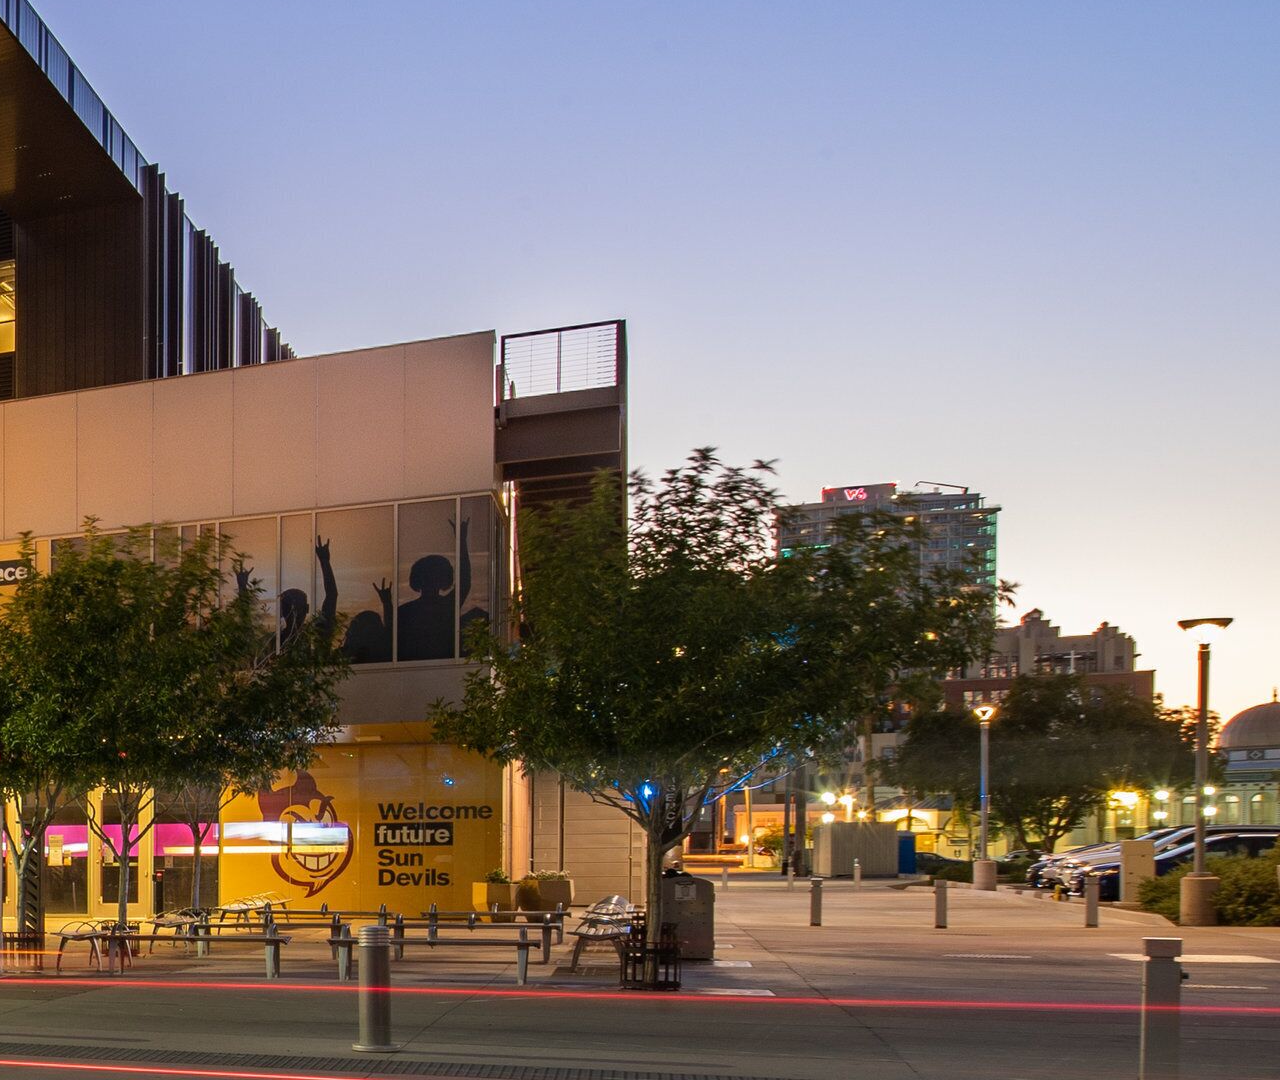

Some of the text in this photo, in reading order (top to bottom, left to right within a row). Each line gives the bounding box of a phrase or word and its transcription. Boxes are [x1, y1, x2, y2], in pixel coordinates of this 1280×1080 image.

[378, 802, 493, 820] Welcome
[377, 825, 451, 844] future
[378, 849, 423, 867] Sun
[378, 869, 450, 887] Devils
